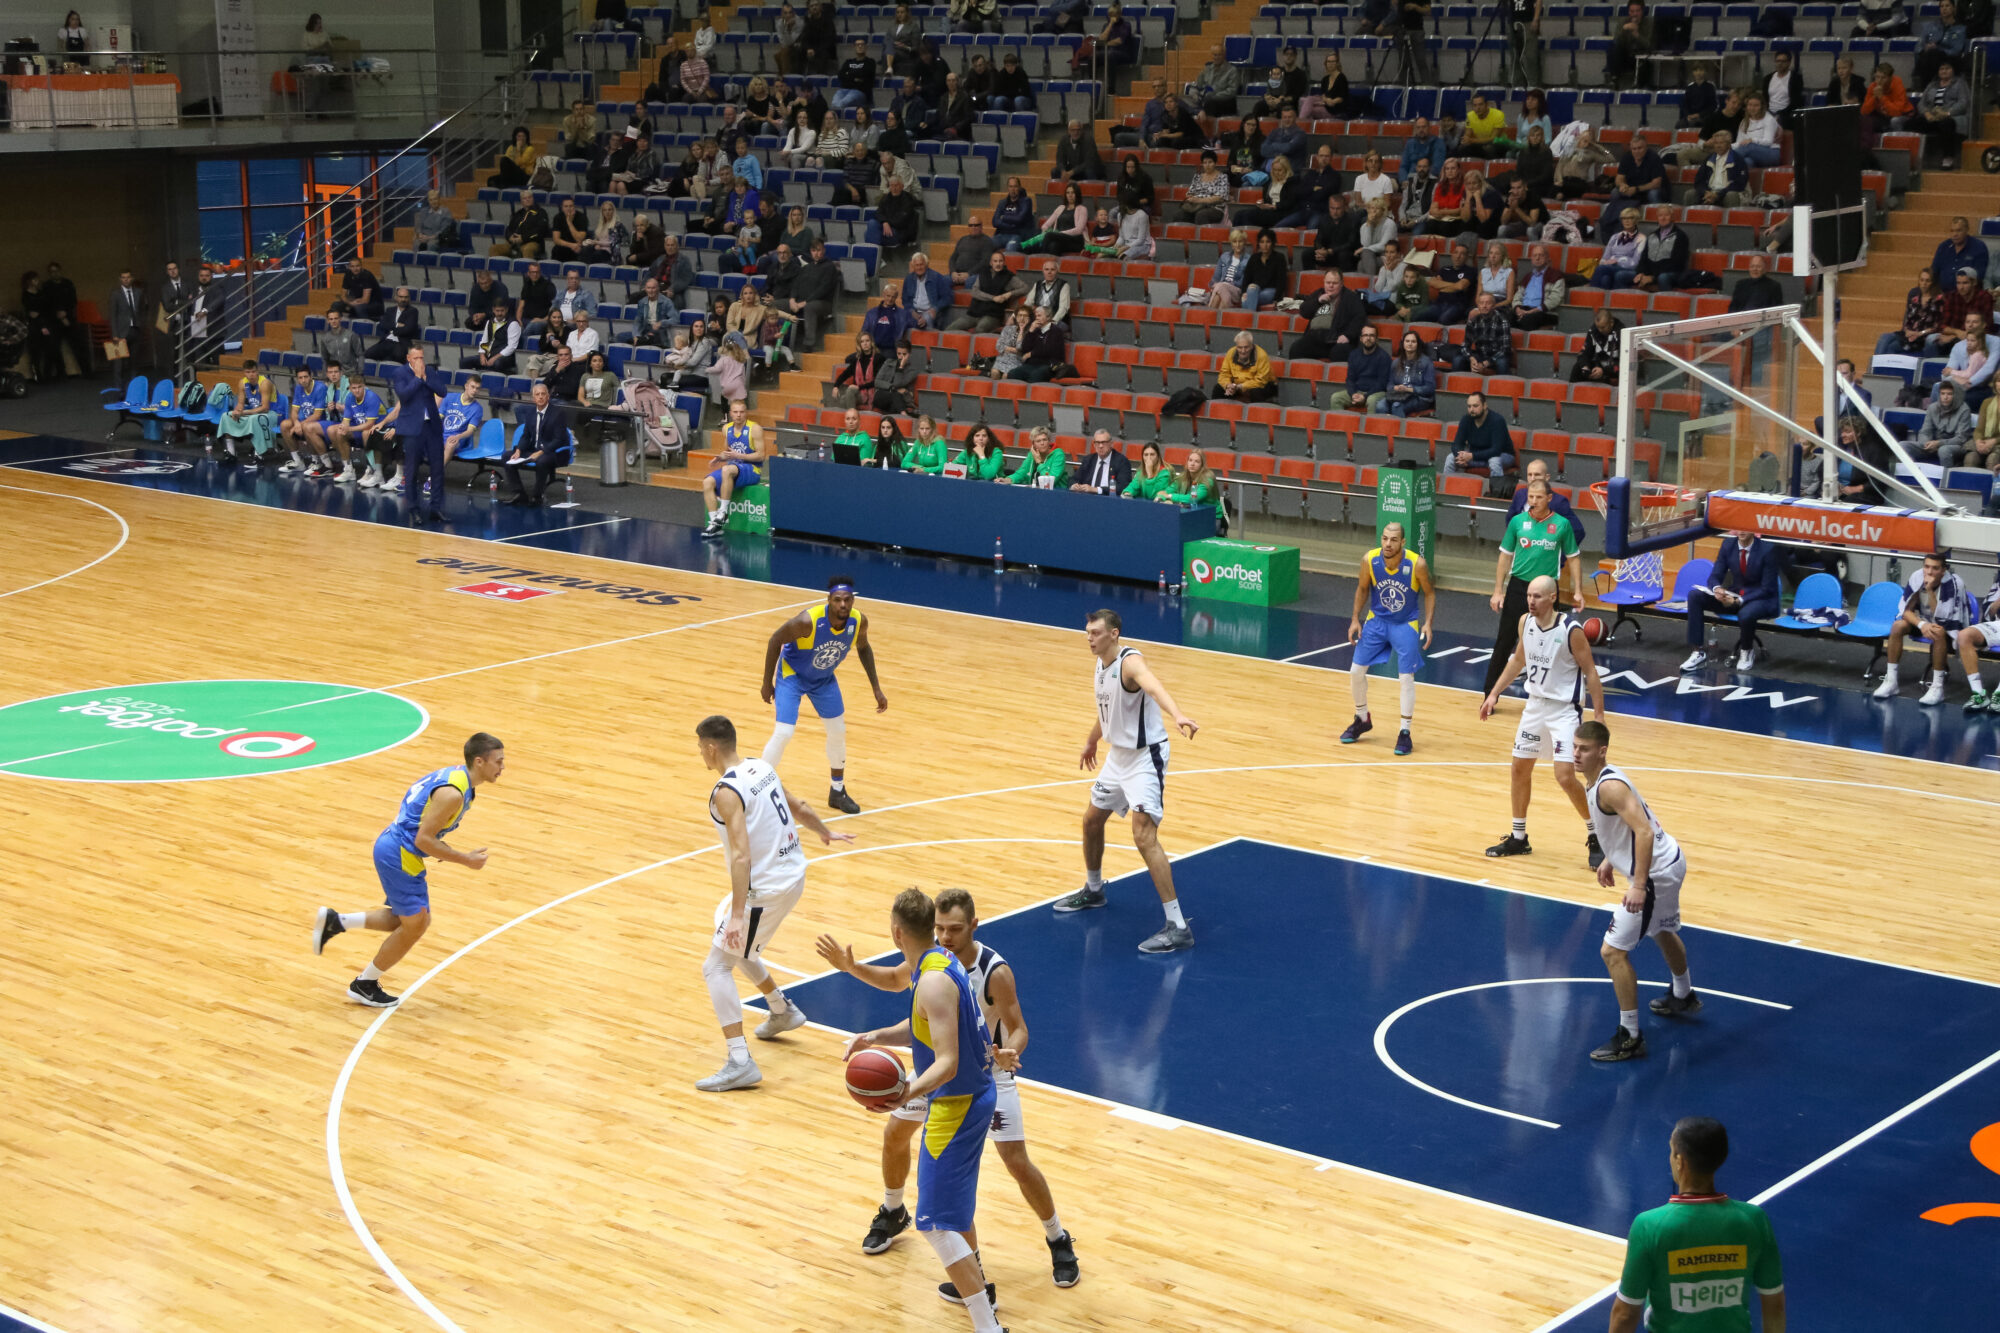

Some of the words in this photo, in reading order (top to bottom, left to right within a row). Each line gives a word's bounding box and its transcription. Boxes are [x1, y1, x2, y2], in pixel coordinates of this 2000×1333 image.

[729, 499, 767, 516] pafbet
[1384, 495, 1405, 505] Latvian
[1382, 504, 1407, 513] Estonian
[748, 513, 767, 523] score
[1756, 513, 1883, 542] www.loc.lv
[1531, 538, 1557, 548] pafbet
[1214, 563, 1263, 583] pafbet
[1239, 580, 1262, 591] score
[1376, 579, 1409, 593] VENTSPILS
[1389, 589, 1396, 599] 0
[820, 649, 837, 659] 22
[1529, 665, 1551, 686] 27
[104, 696, 186, 715] score
[58, 700, 248, 739] pafbet
[770, 787, 789, 826] 6
[1677, 1252, 1740, 1268] RAMIRENT
[1679, 1284, 1739, 1308] Helio
